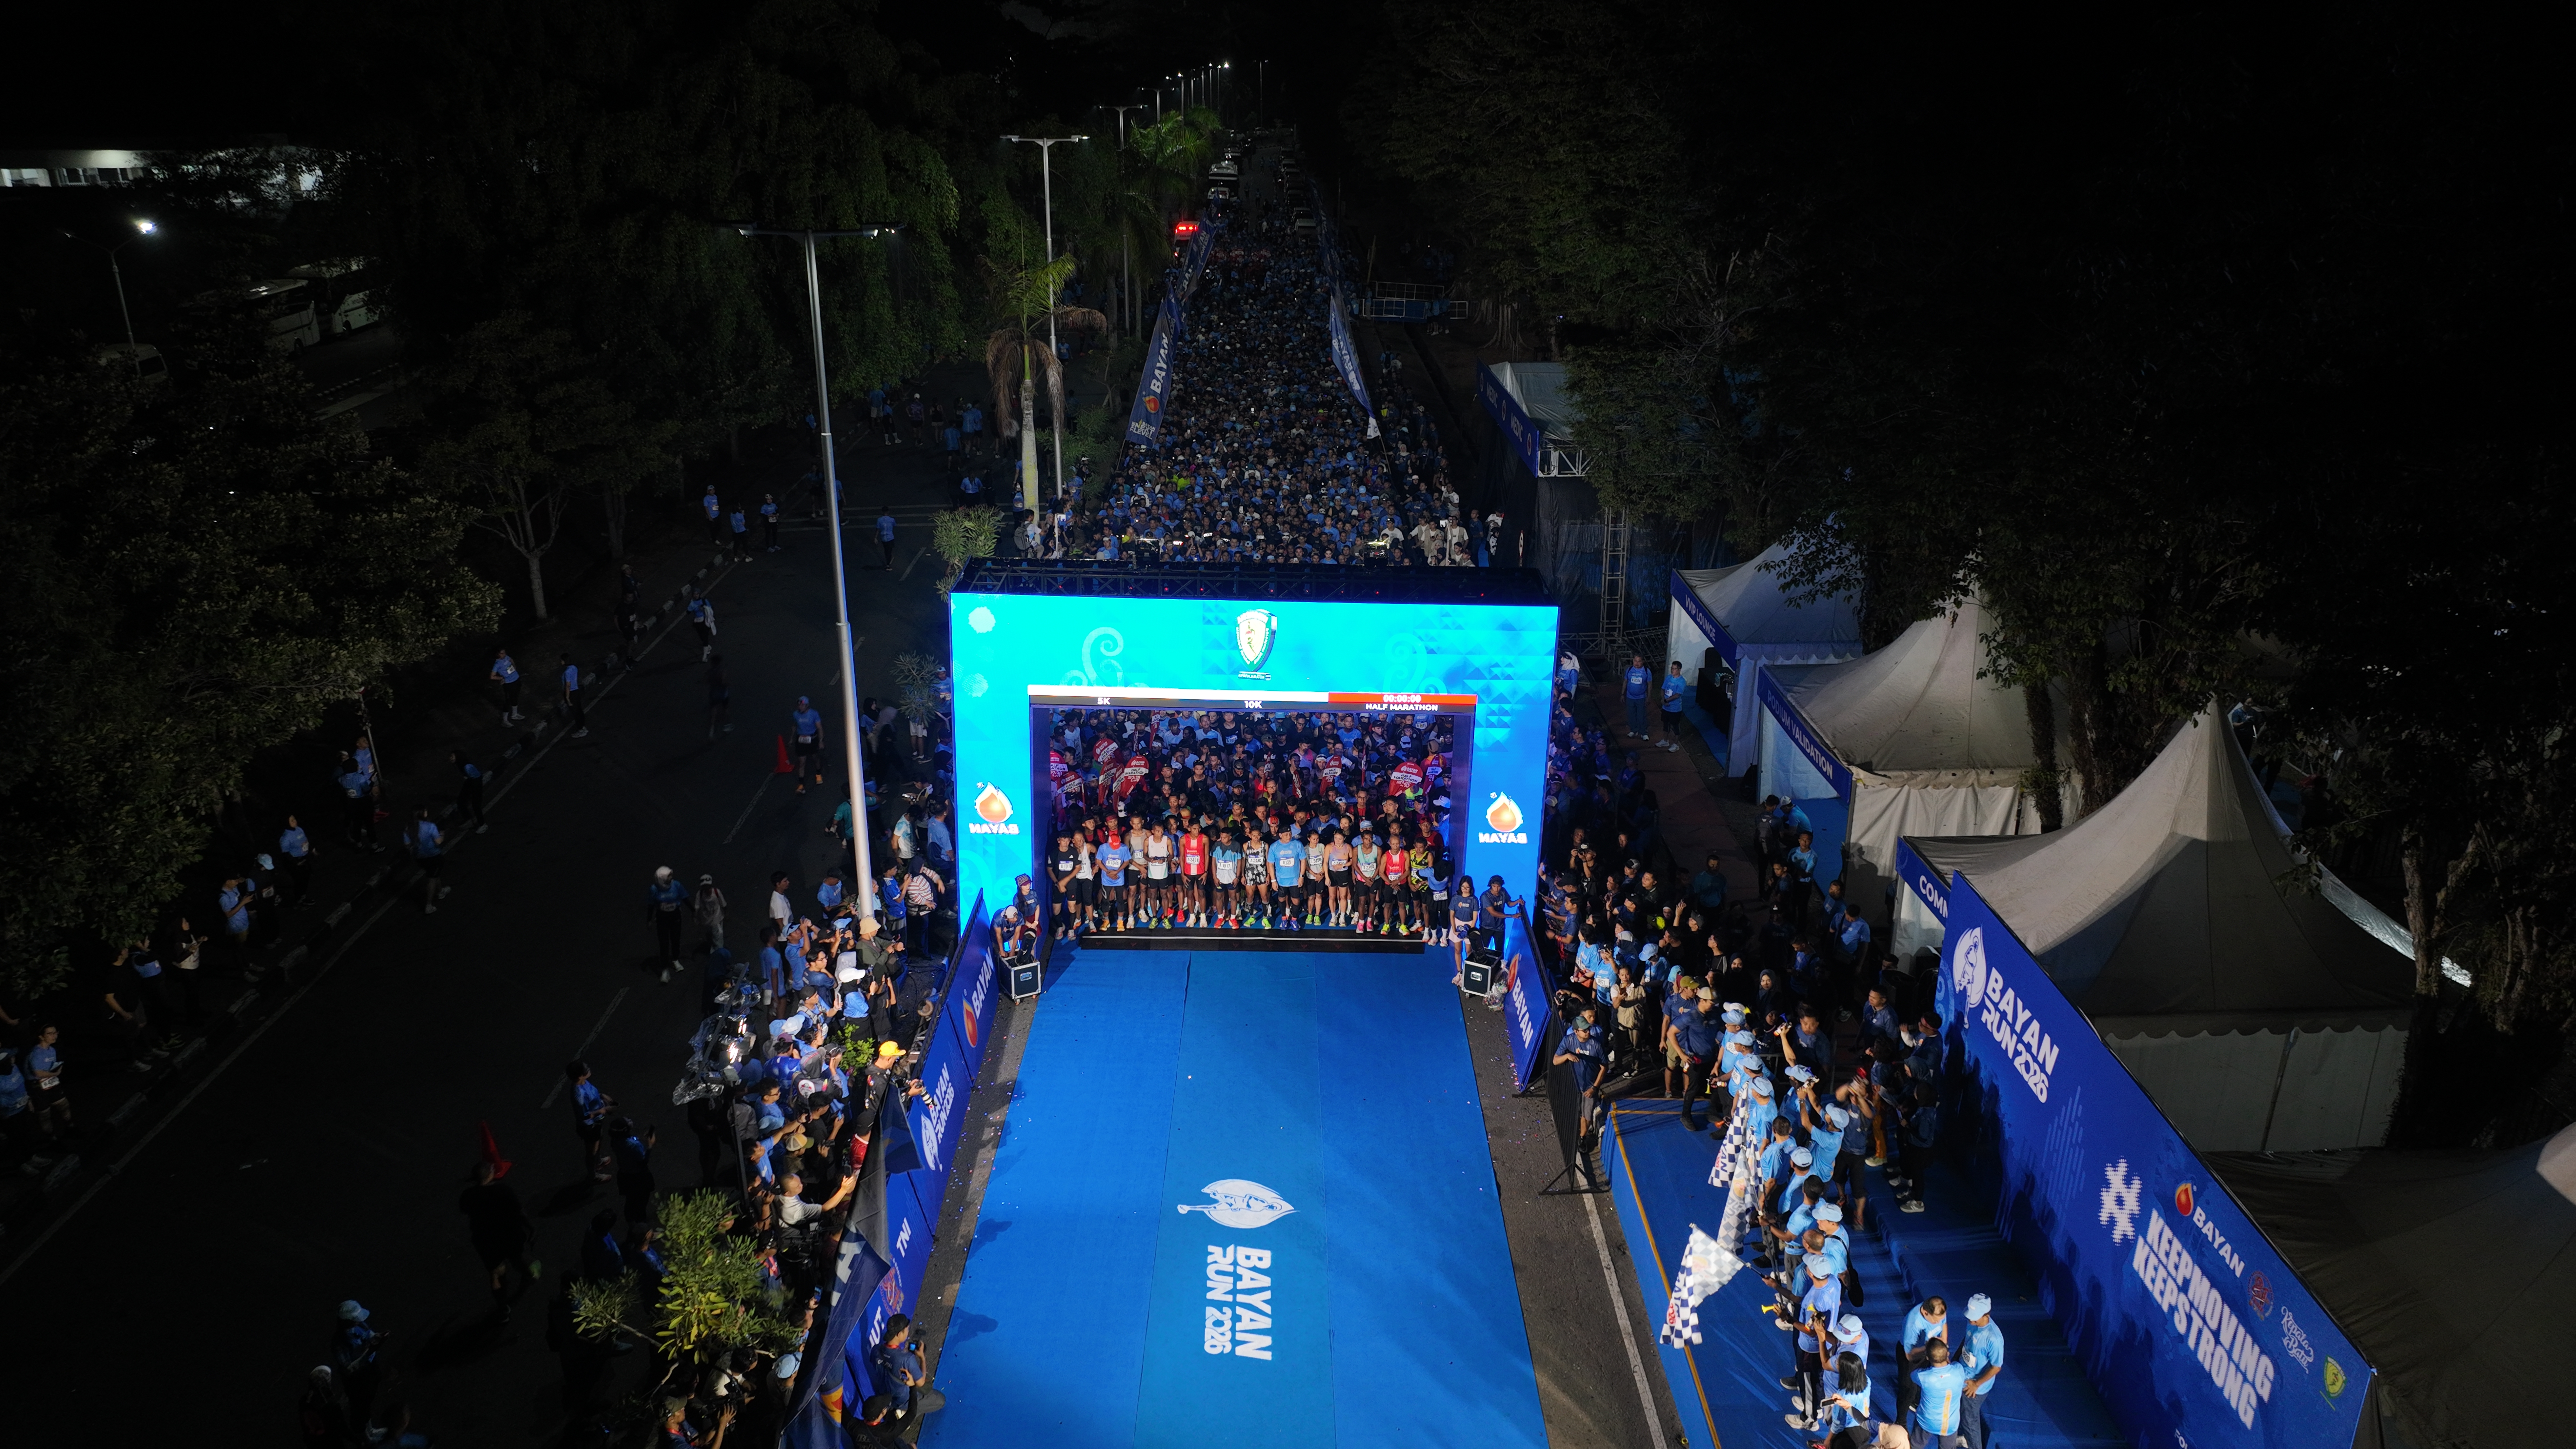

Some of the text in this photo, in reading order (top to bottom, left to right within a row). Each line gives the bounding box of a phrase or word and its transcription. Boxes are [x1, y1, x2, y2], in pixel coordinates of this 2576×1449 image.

[1150, 332, 1168, 394] BAYAN
[1487, 382, 1498, 408] MEDIC
[1133, 429, 1152, 440] LEVEL
[1135, 420, 1155, 435] NEXT
[1142, 422, 1156, 430] BAYAN
[1511, 412, 1523, 442] MEDIC
[1686, 594, 1715, 642] VVIP LOUNGE
[1768, 689, 1833, 780] PODIUM VALIDATION
[972, 946, 994, 1020] BAYAN
[1512, 977, 1533, 1049] BAYAN
[1981, 995, 2049, 1103] RUN 2026
[1986, 966, 2059, 1076] BAYAN
[929, 1062, 950, 1128] BAYAN
[896, 1217, 911, 1258] TNI
[2193, 1207, 2245, 1277] BAYAN
[1204, 1244, 1234, 1354] RUN 2026
[1235, 1246, 1272, 1360] BAYAN
[2133, 1234, 2257, 1430] KEEPSTRONG
[2146, 1208, 2274, 1404] KEEPMOVING
